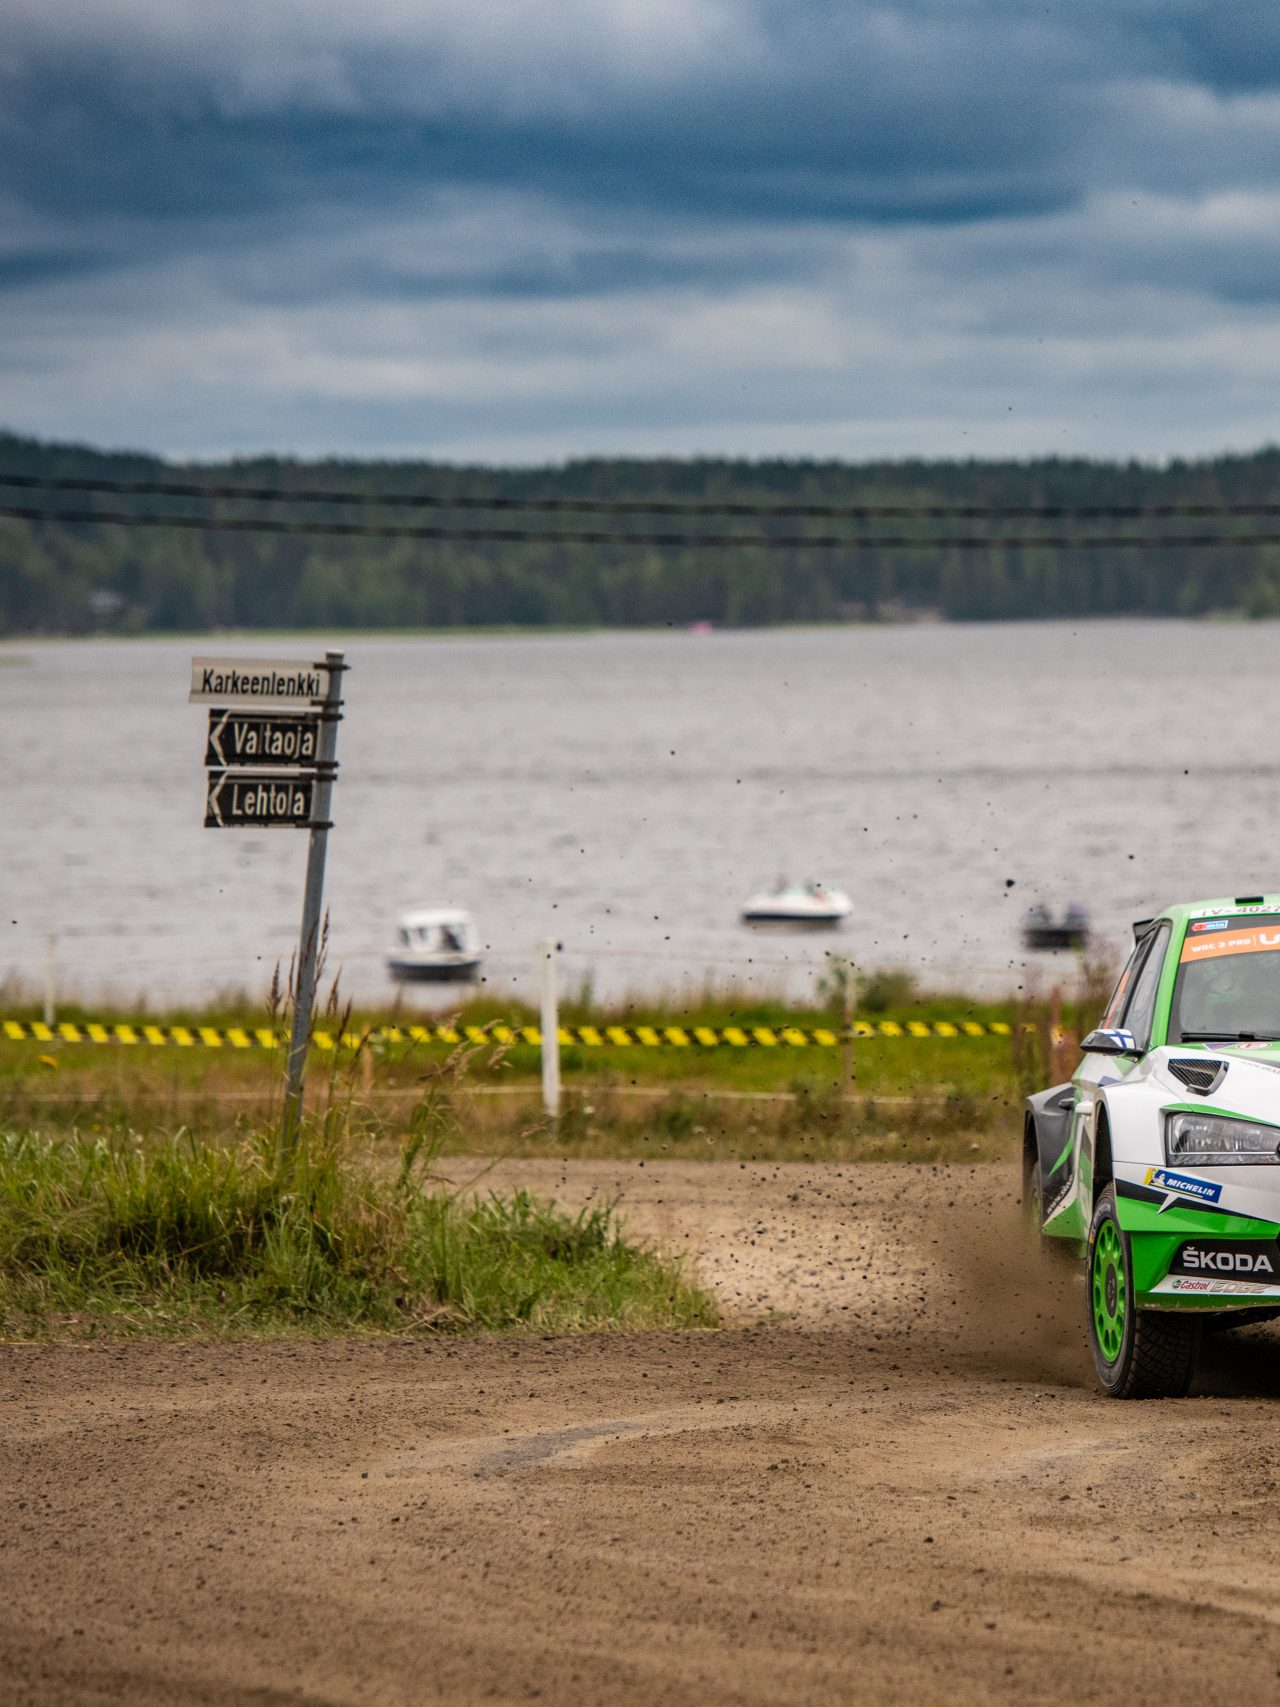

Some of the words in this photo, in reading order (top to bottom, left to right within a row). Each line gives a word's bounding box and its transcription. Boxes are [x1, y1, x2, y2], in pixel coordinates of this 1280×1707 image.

[201, 668, 320, 697] Karkeenlenkki
[232, 784, 305, 816] Lehtola
[1191, 943, 1216, 952] WRC
[1228, 938, 1251, 946] PRO
[1166, 1178, 1215, 1196] MICHELIN
[1182, 1246, 1274, 1273] ŠKODA
[1180, 1280, 1210, 1291] Castrol
[1210, 1280, 1271, 1294] EDGE
